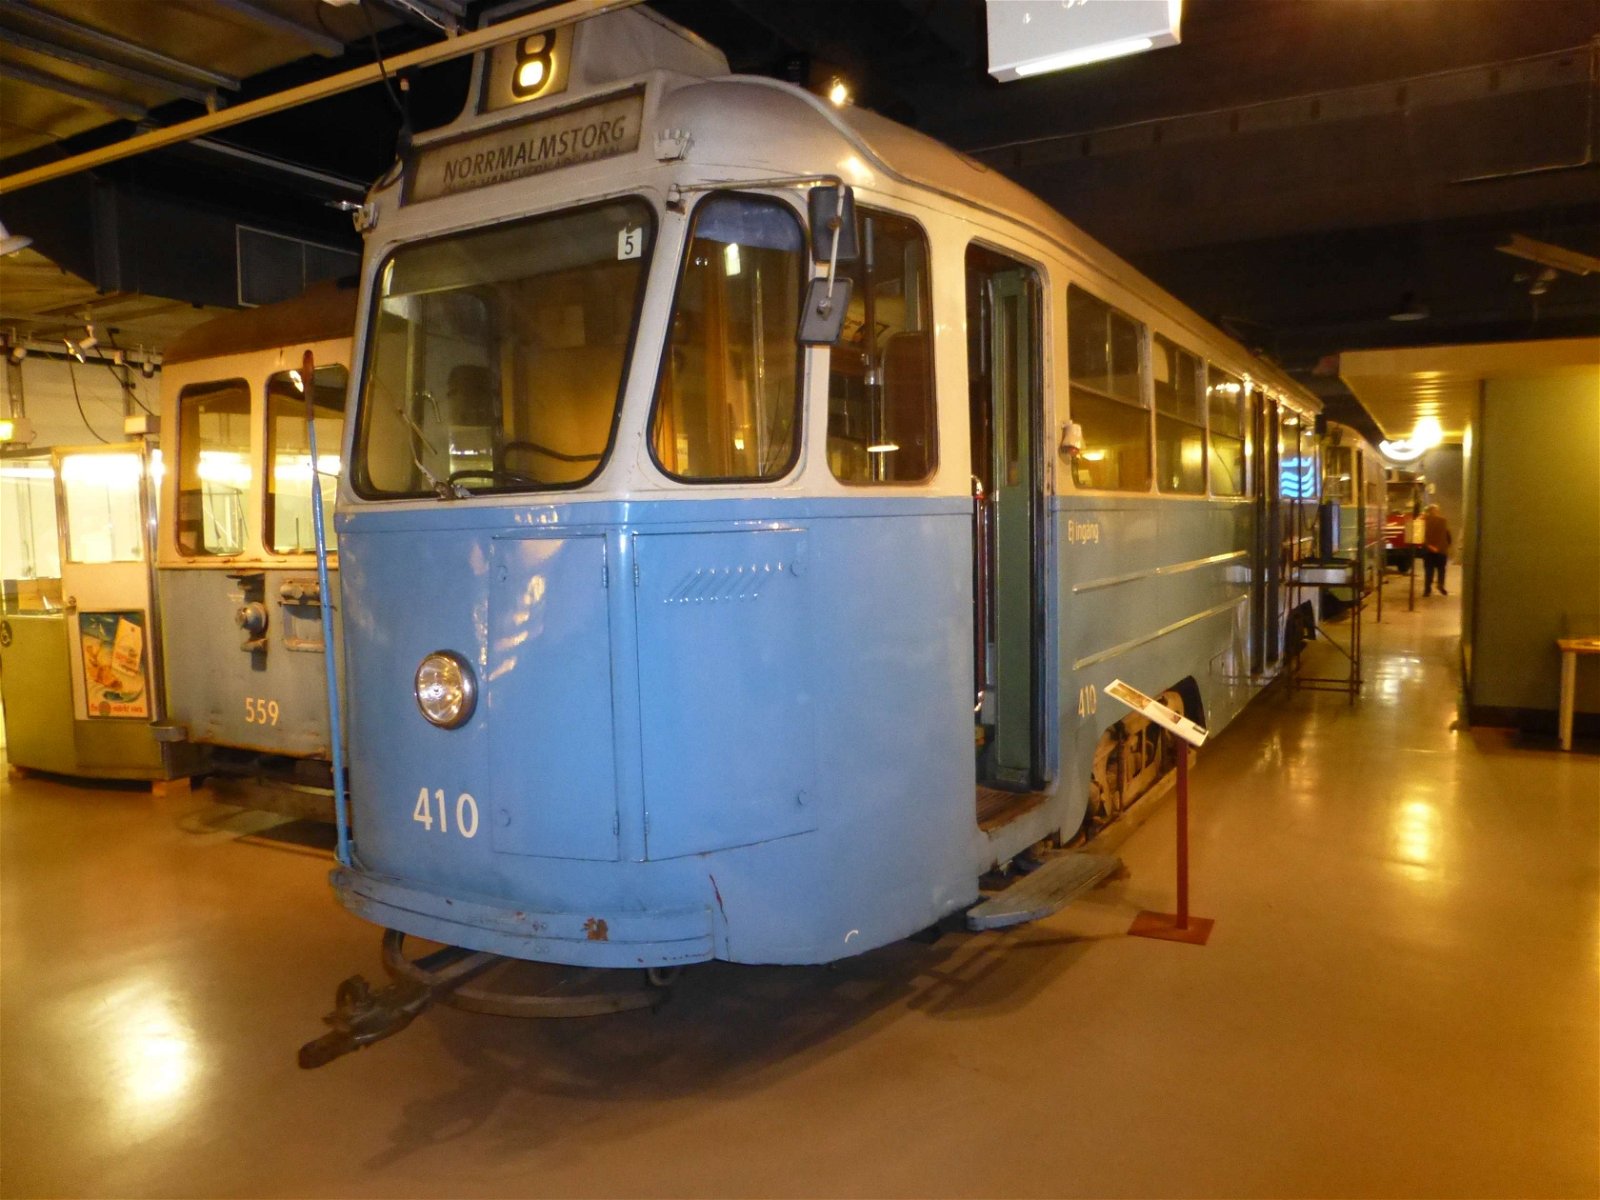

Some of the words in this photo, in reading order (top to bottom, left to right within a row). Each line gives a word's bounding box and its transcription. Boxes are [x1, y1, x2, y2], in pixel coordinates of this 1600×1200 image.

[512, 29, 555, 98] 8
[443, 116, 626, 182] NORRMALMSTORG
[624, 235, 634, 255] 5
[245, 697, 279, 726] 559
[1078, 684, 1097, 718] 410
[413, 787, 479, 838] 410
